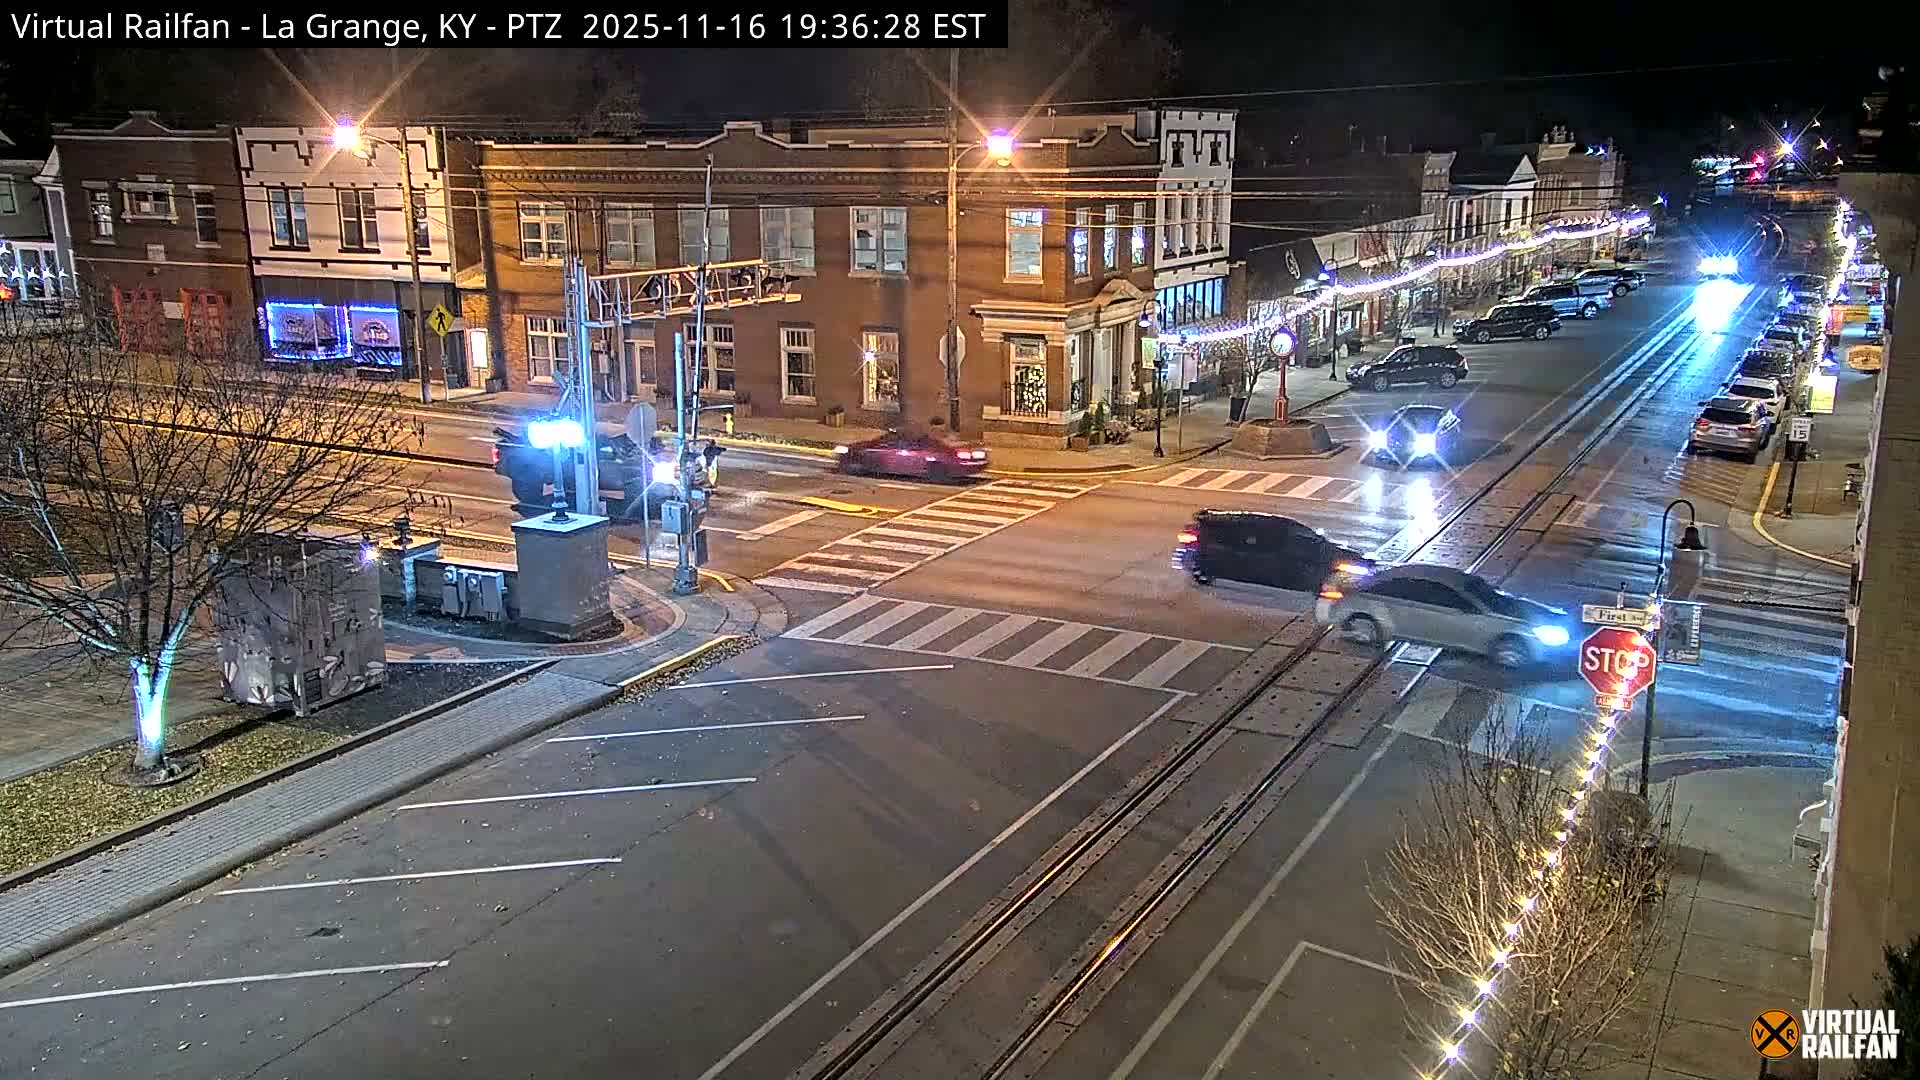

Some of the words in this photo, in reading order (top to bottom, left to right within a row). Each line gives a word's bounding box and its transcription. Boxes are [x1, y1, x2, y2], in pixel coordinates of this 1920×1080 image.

[1793, 429, 1807, 440] 15
[1599, 609, 1627, 622] First
[1584, 646, 1650, 678] STOP
